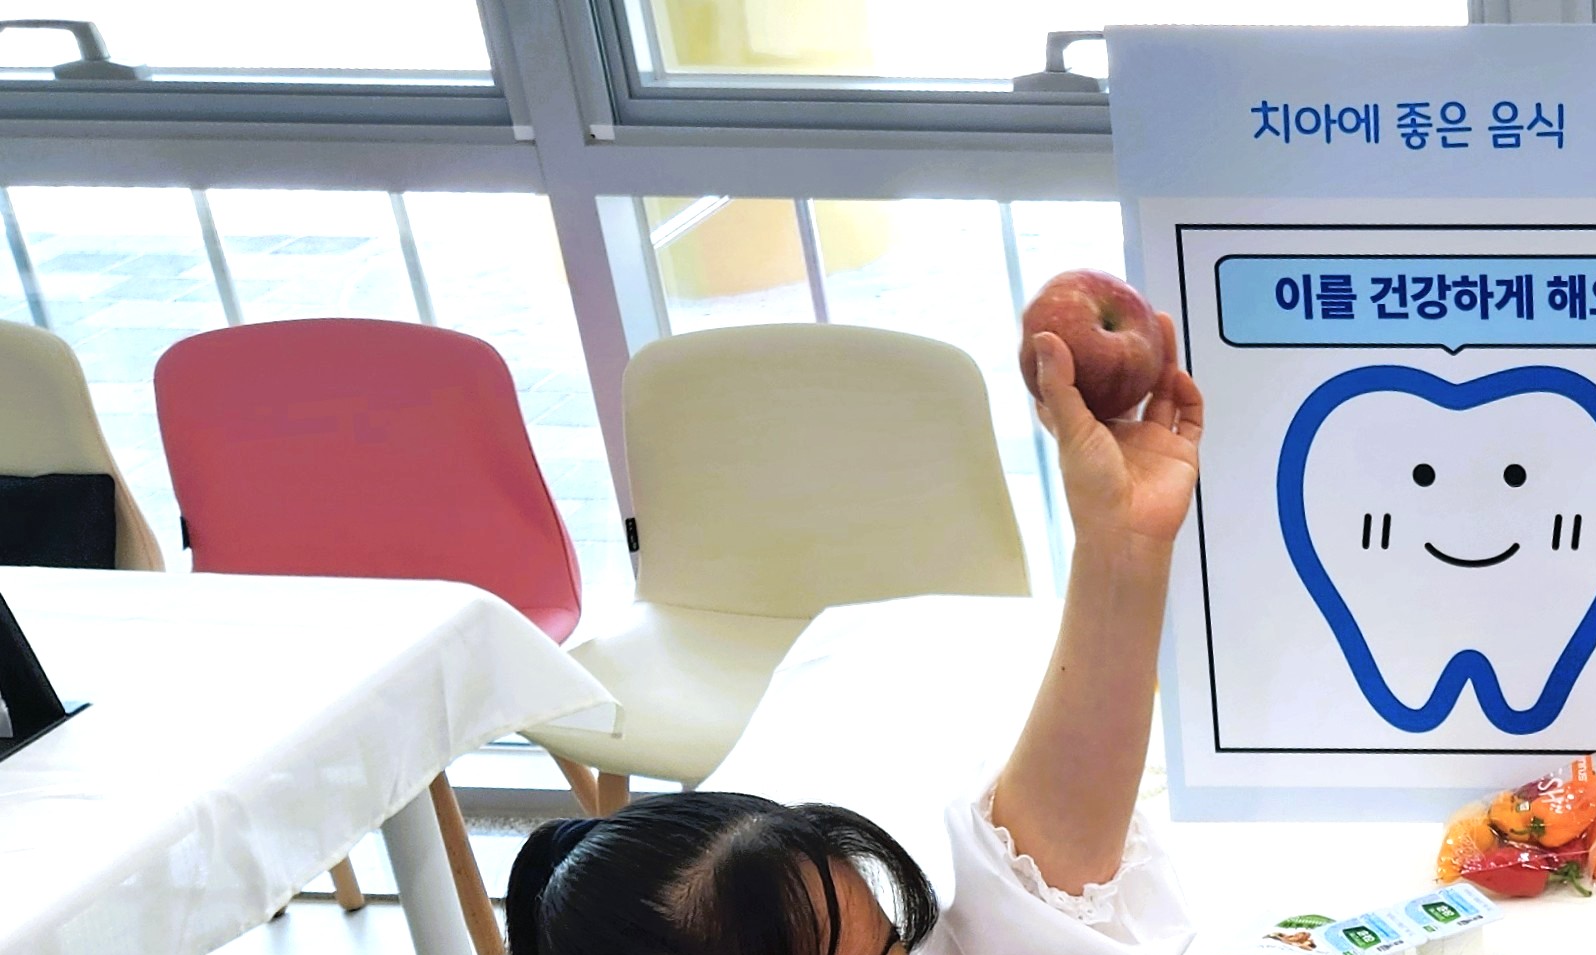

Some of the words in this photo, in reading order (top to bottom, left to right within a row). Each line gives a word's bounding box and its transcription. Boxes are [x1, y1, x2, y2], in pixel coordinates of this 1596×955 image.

[1250, 100, 1382, 145] 치아에
[1396, 100, 1474, 151] 좋은
[1487, 100, 1566, 150] 음식
[1274, 272, 1358, 321] 이를
[1369, 272, 1536, 321] 건강하게
